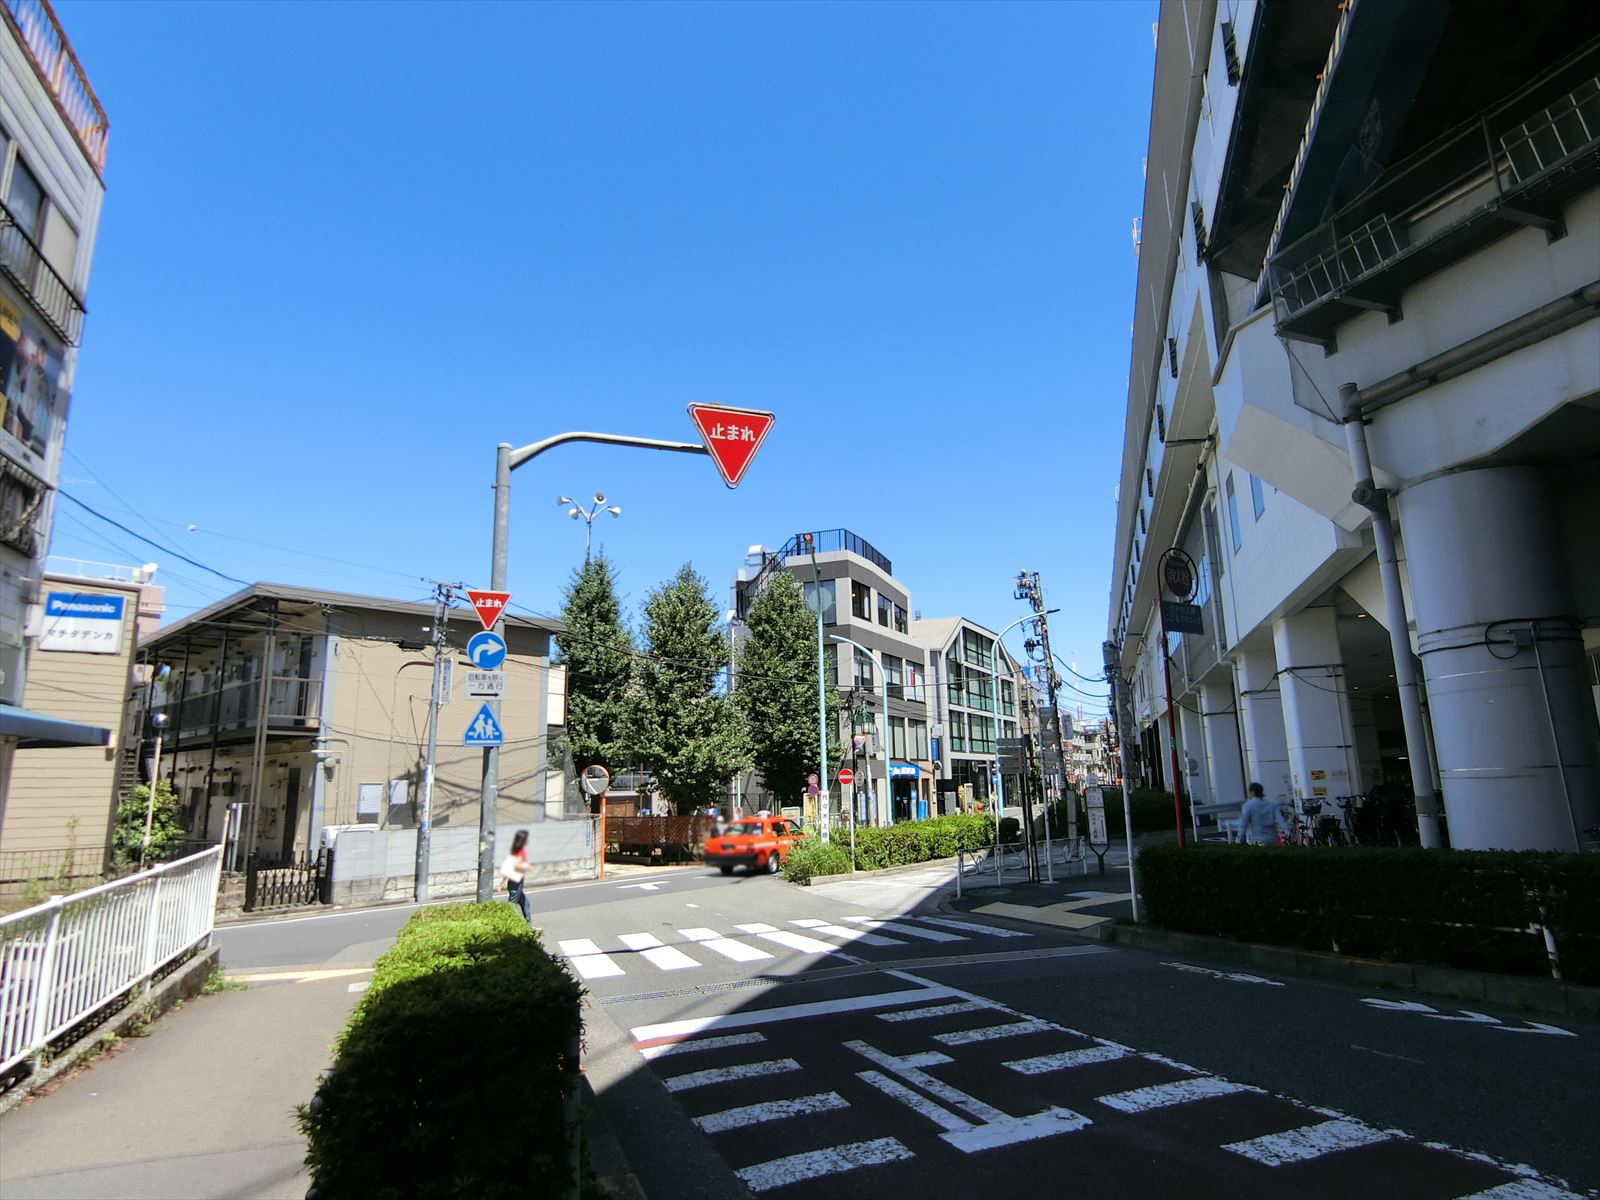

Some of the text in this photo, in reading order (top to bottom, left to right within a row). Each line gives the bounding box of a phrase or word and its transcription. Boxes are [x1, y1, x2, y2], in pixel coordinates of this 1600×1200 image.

[710, 423, 756, 442] 止まれ
[51, 600, 116, 613] Panasonic
[476, 597, 503, 608] 止まれ
[468, 673, 504, 682] 自転車を除く
[468, 682, 504, 691] 一方通行
